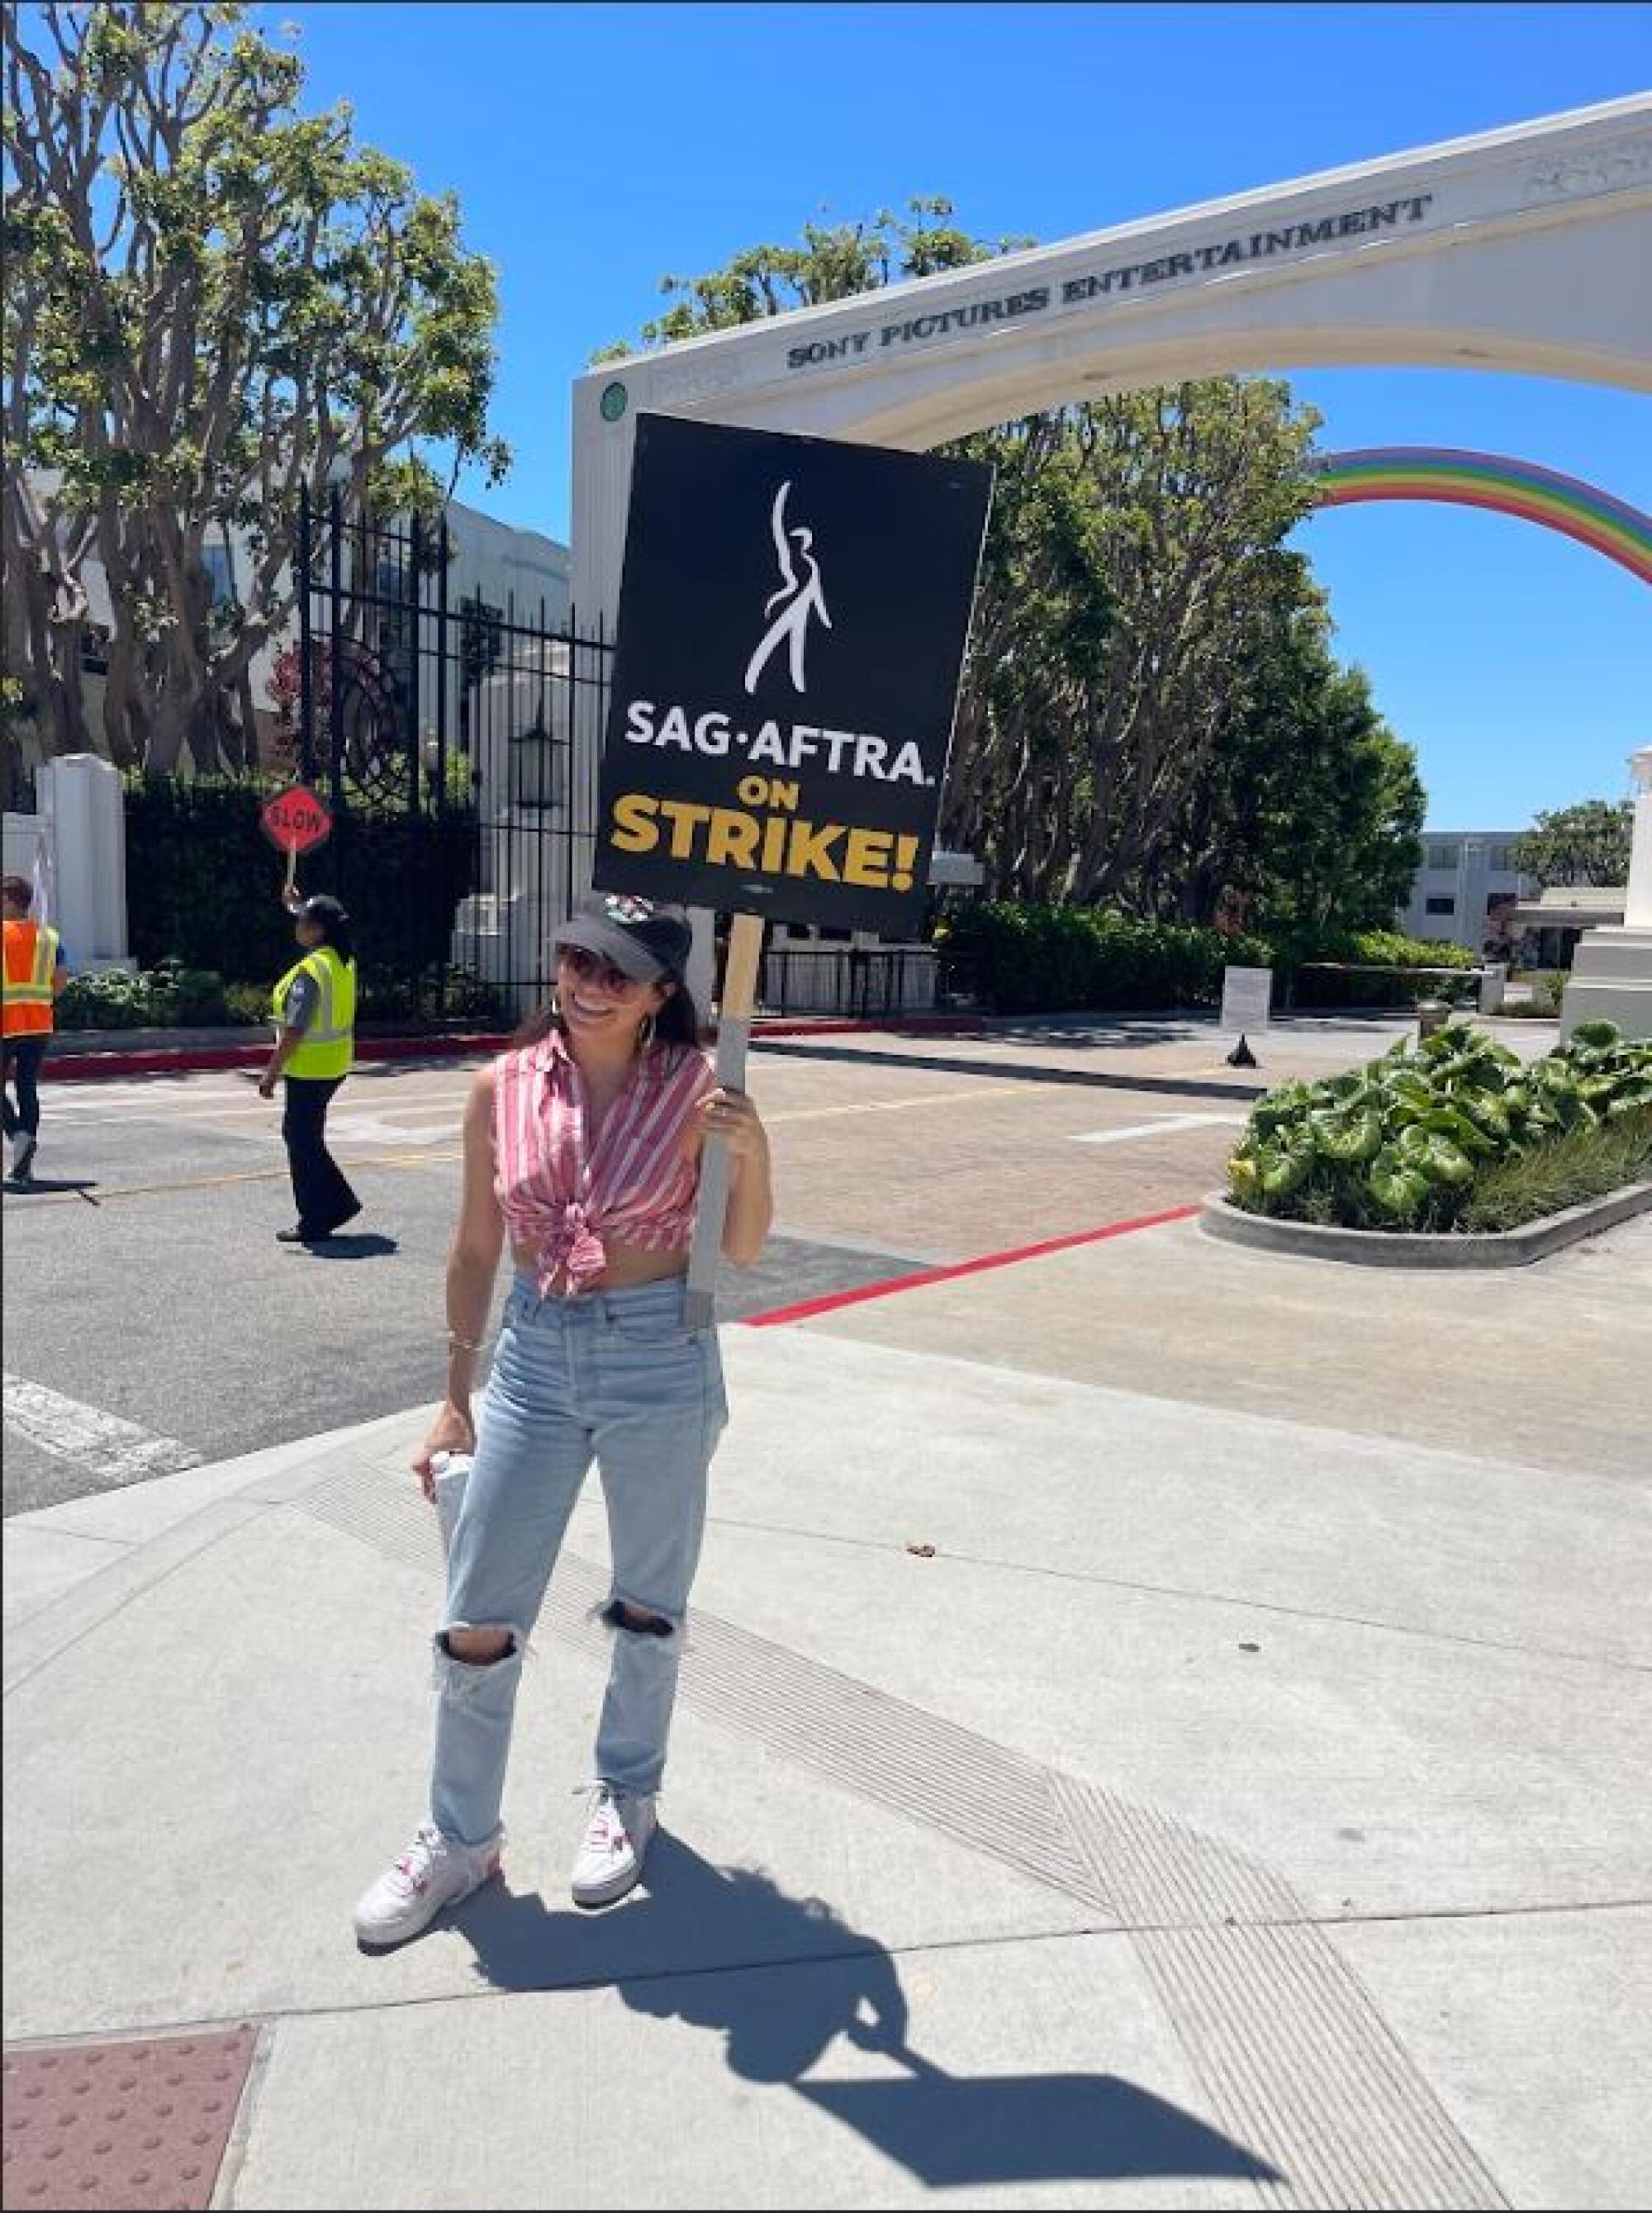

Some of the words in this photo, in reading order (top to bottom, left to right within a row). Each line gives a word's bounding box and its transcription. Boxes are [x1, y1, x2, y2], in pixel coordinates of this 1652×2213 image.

[787, 332, 871, 369] SONY
[881, 287, 1050, 347] PICTURES
[1062, 192, 1433, 303] ENTERTAINMENT
[269, 805, 322, 833] SLOW
[737, 775, 800, 811] ON
[611, 794, 919, 891] STRIKE!
